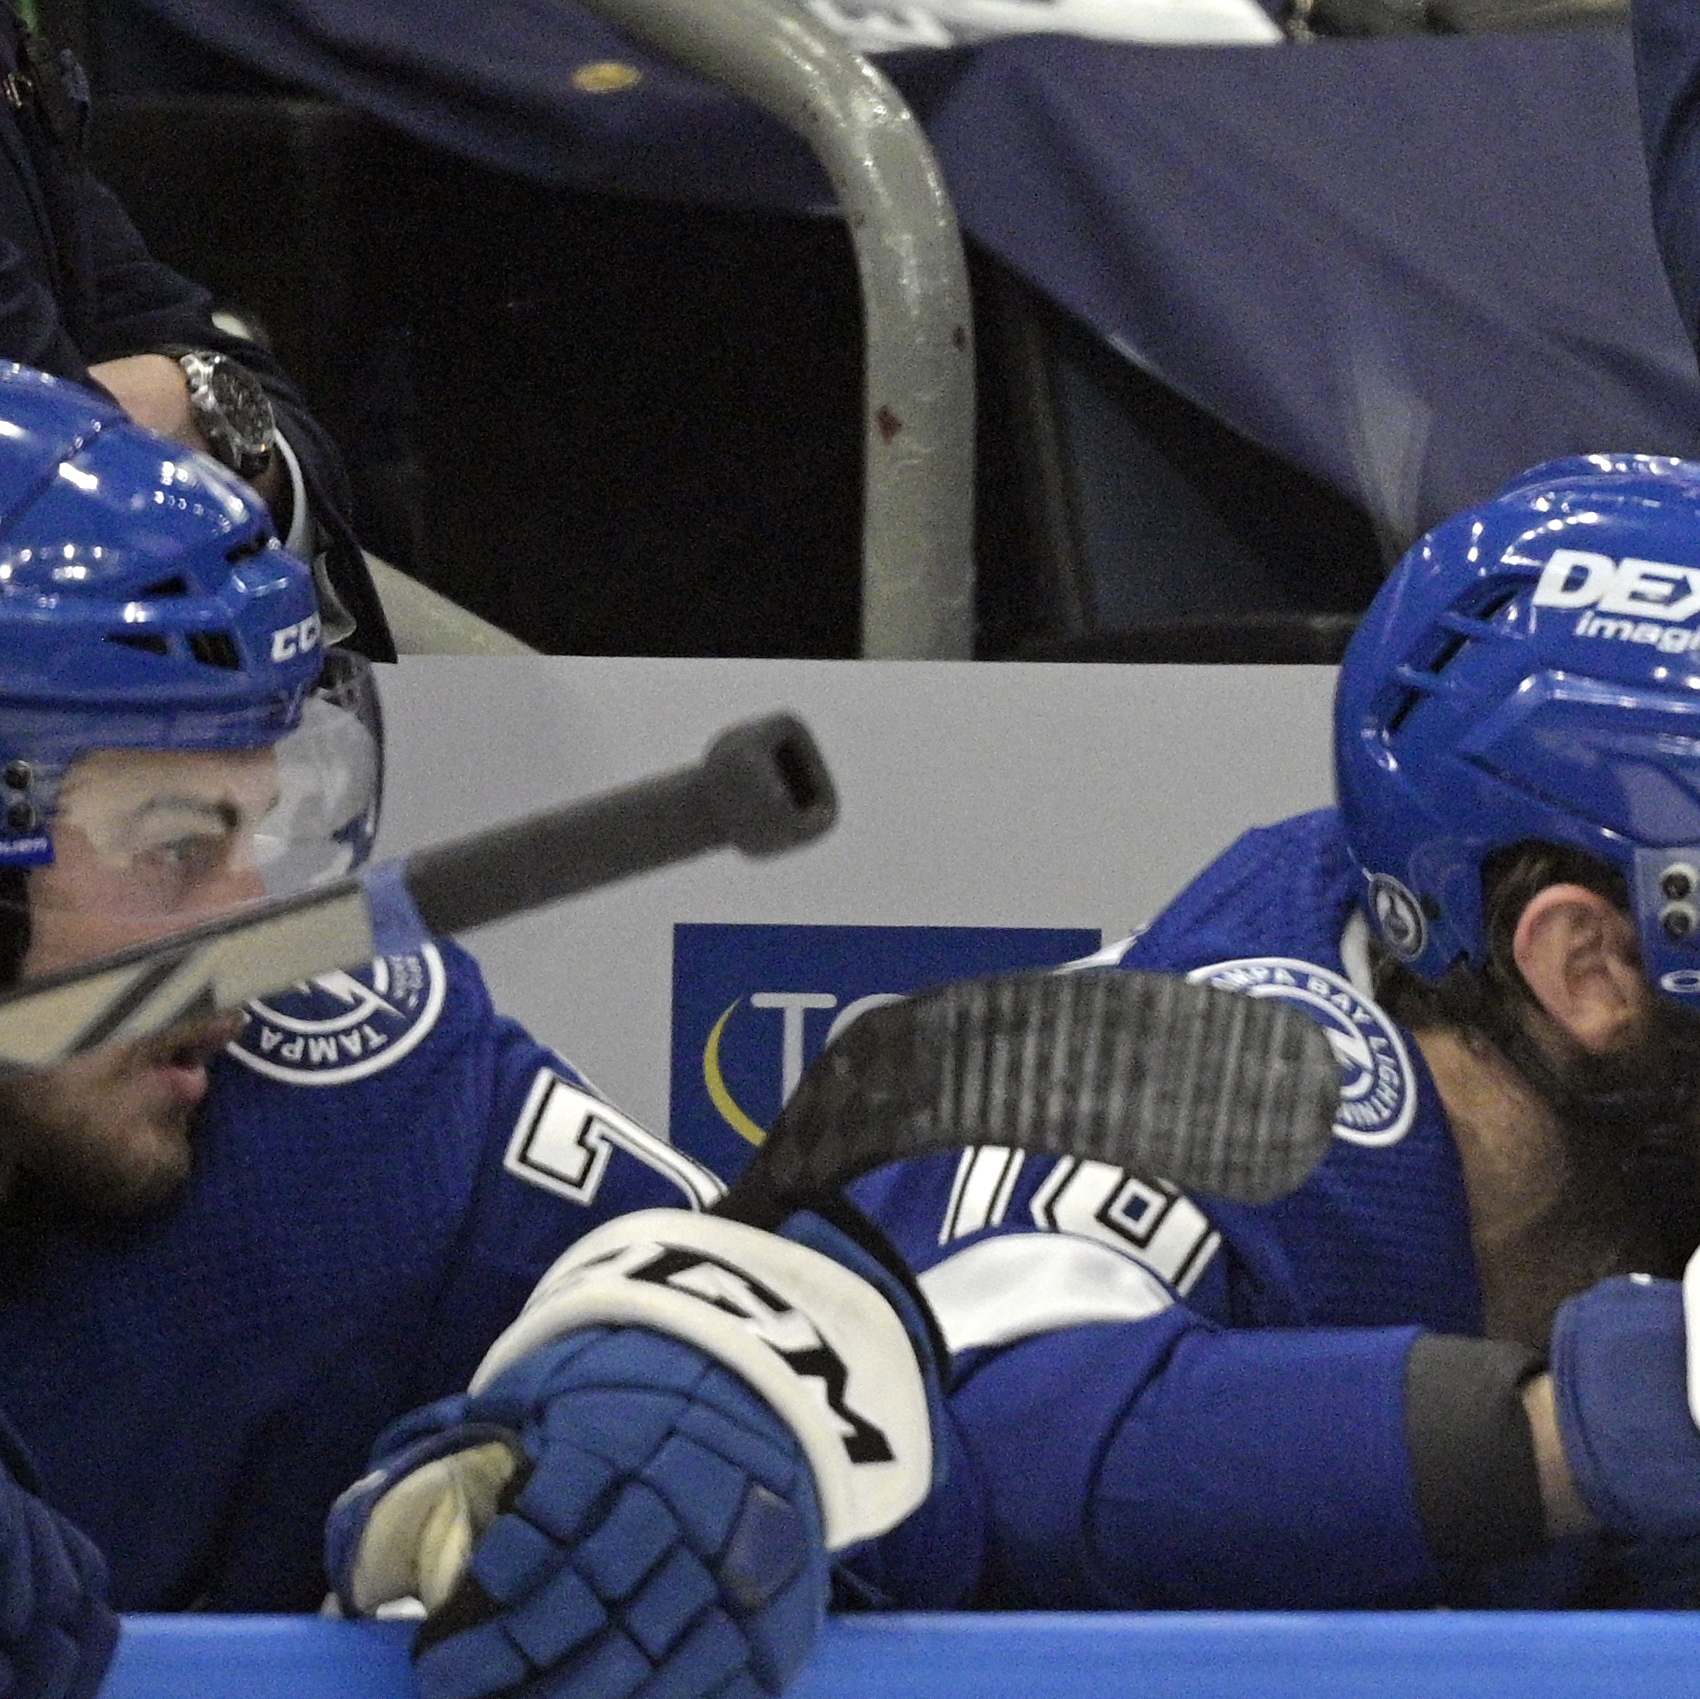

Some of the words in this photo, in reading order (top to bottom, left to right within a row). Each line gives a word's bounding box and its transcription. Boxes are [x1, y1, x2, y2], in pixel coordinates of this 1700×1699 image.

[1307, 975, 1375, 1023] BAY
[261, 1023, 389, 1065] TAMPA
[562, 1240, 897, 1465] CM
